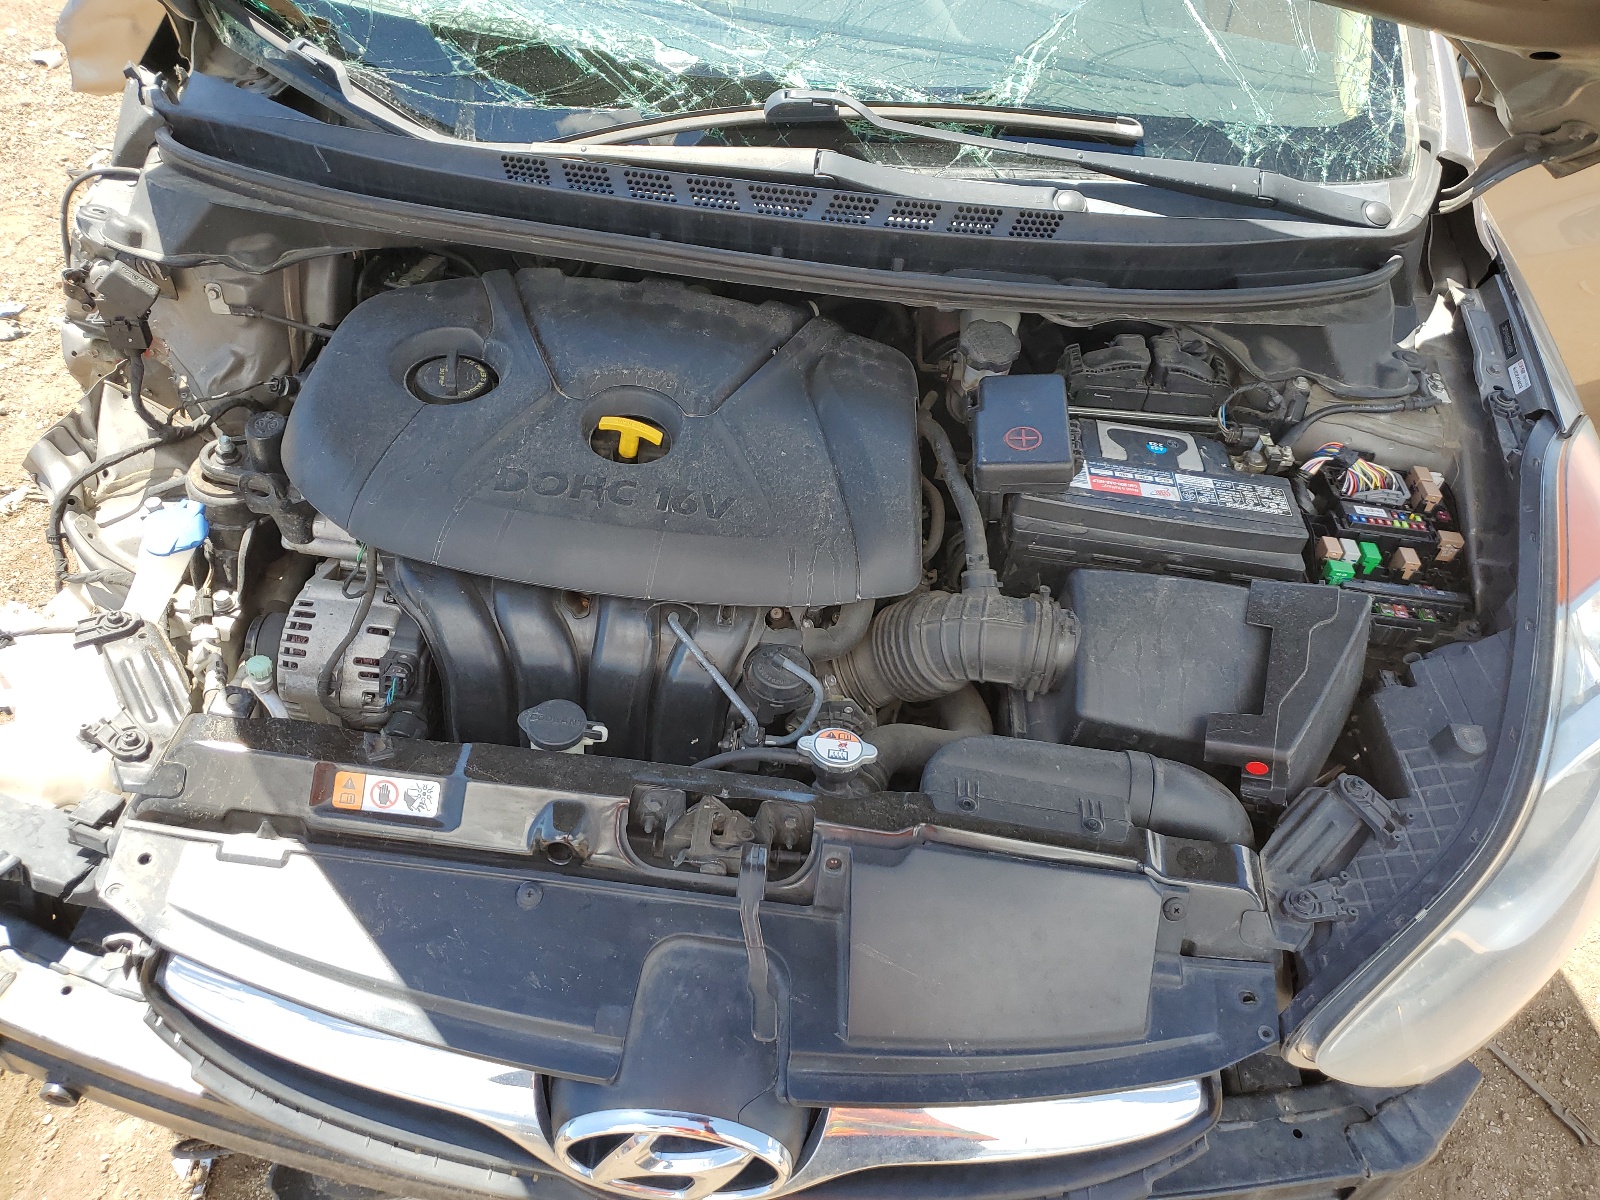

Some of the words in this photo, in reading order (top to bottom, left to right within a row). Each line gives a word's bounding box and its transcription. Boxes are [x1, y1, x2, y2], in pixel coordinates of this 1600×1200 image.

[493, 467, 639, 507] DOHC
[655, 485, 738, 520] 16V
[528, 711, 583, 727] COOLANT
